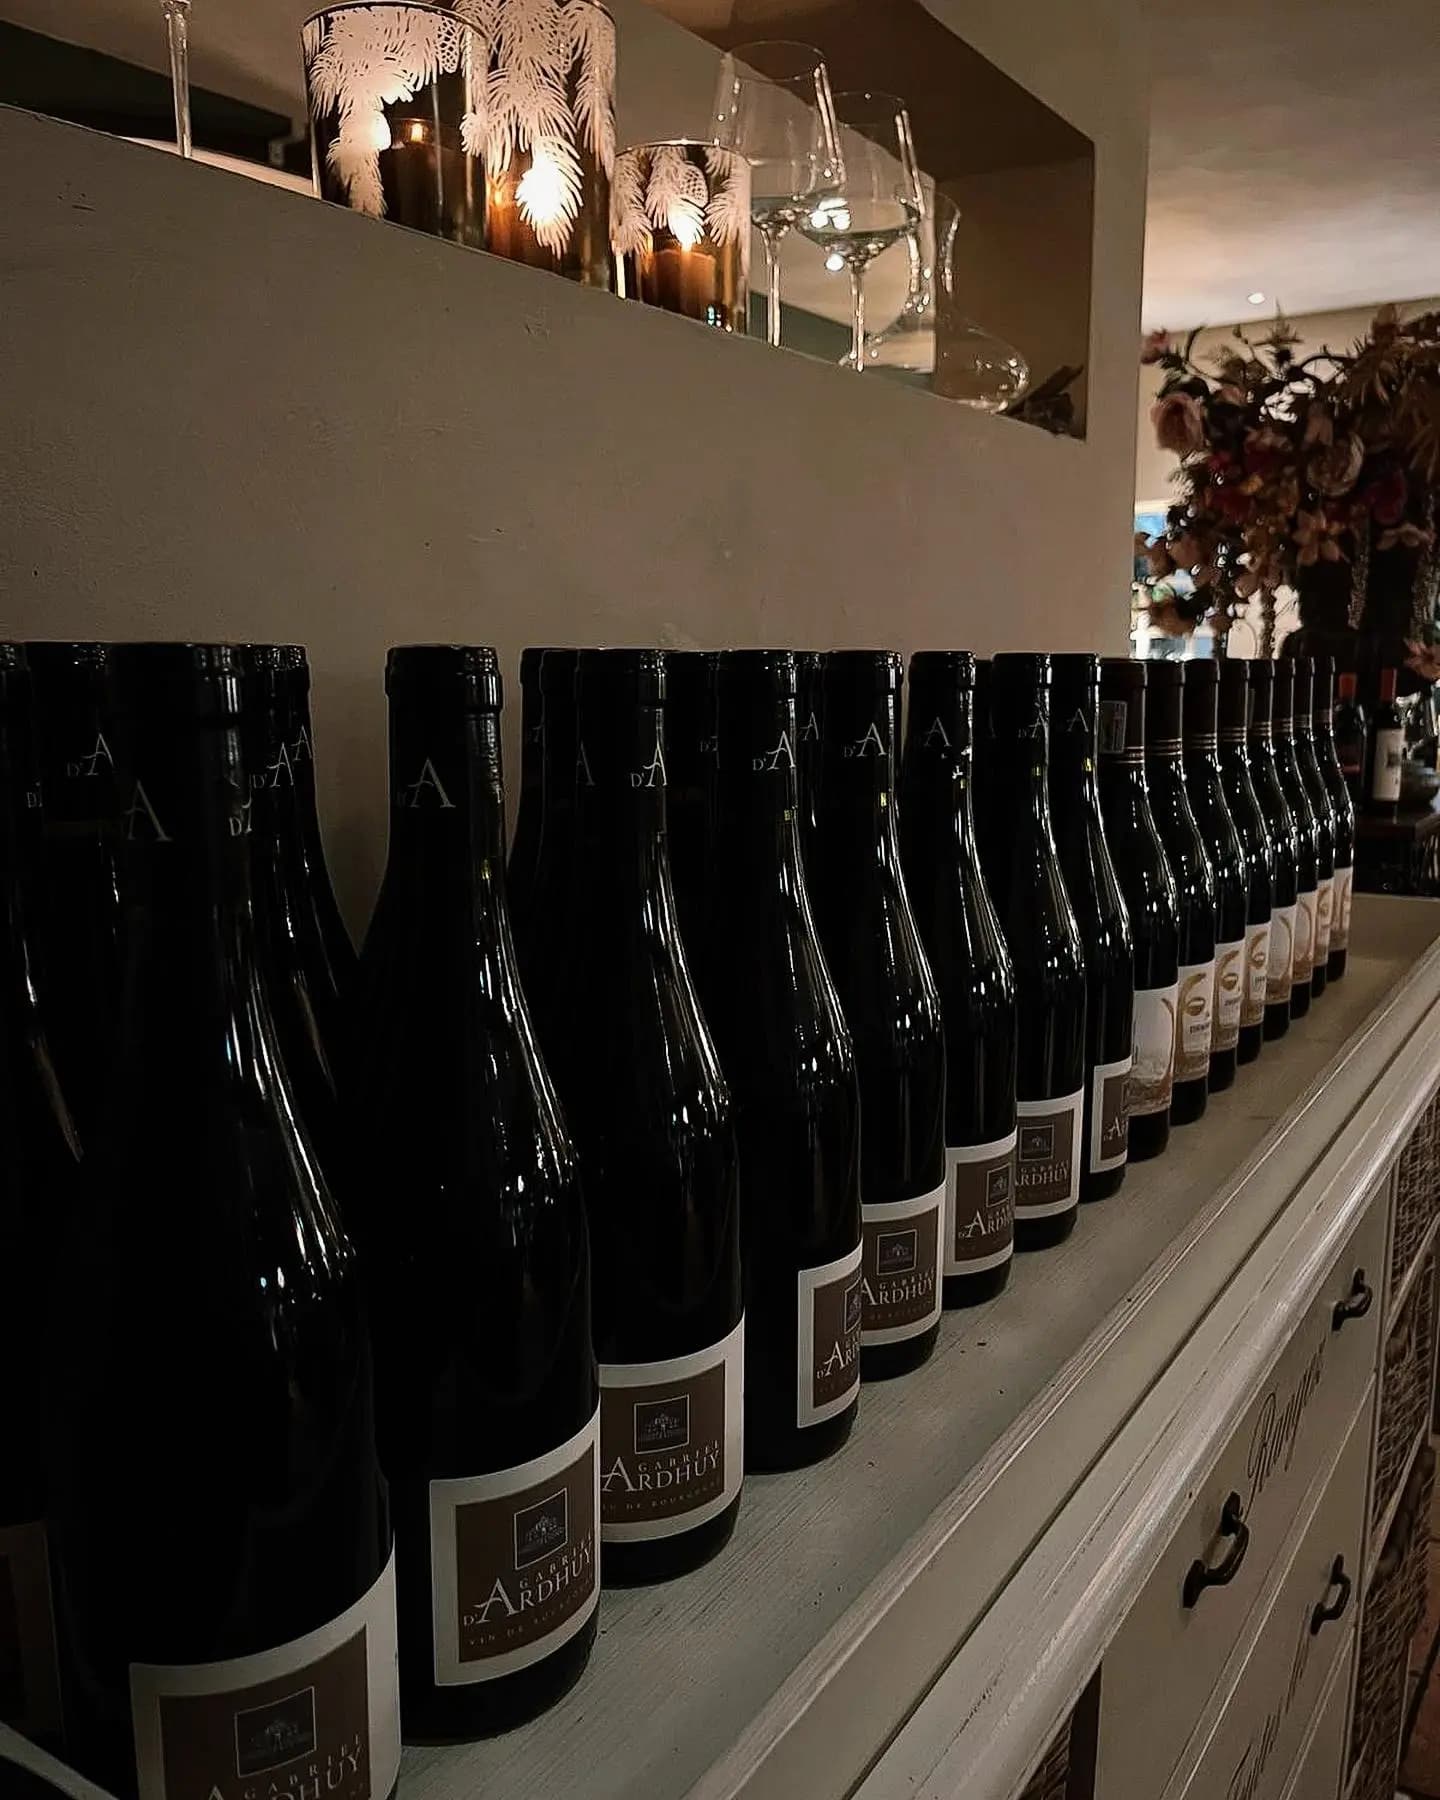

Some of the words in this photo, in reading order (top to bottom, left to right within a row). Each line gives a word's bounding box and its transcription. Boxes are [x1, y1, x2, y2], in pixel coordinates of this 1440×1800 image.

[630, 741, 669, 788] D'A
[752, 730, 797, 771] D'A
[463, 1547, 592, 1628] D'ARDHUY
